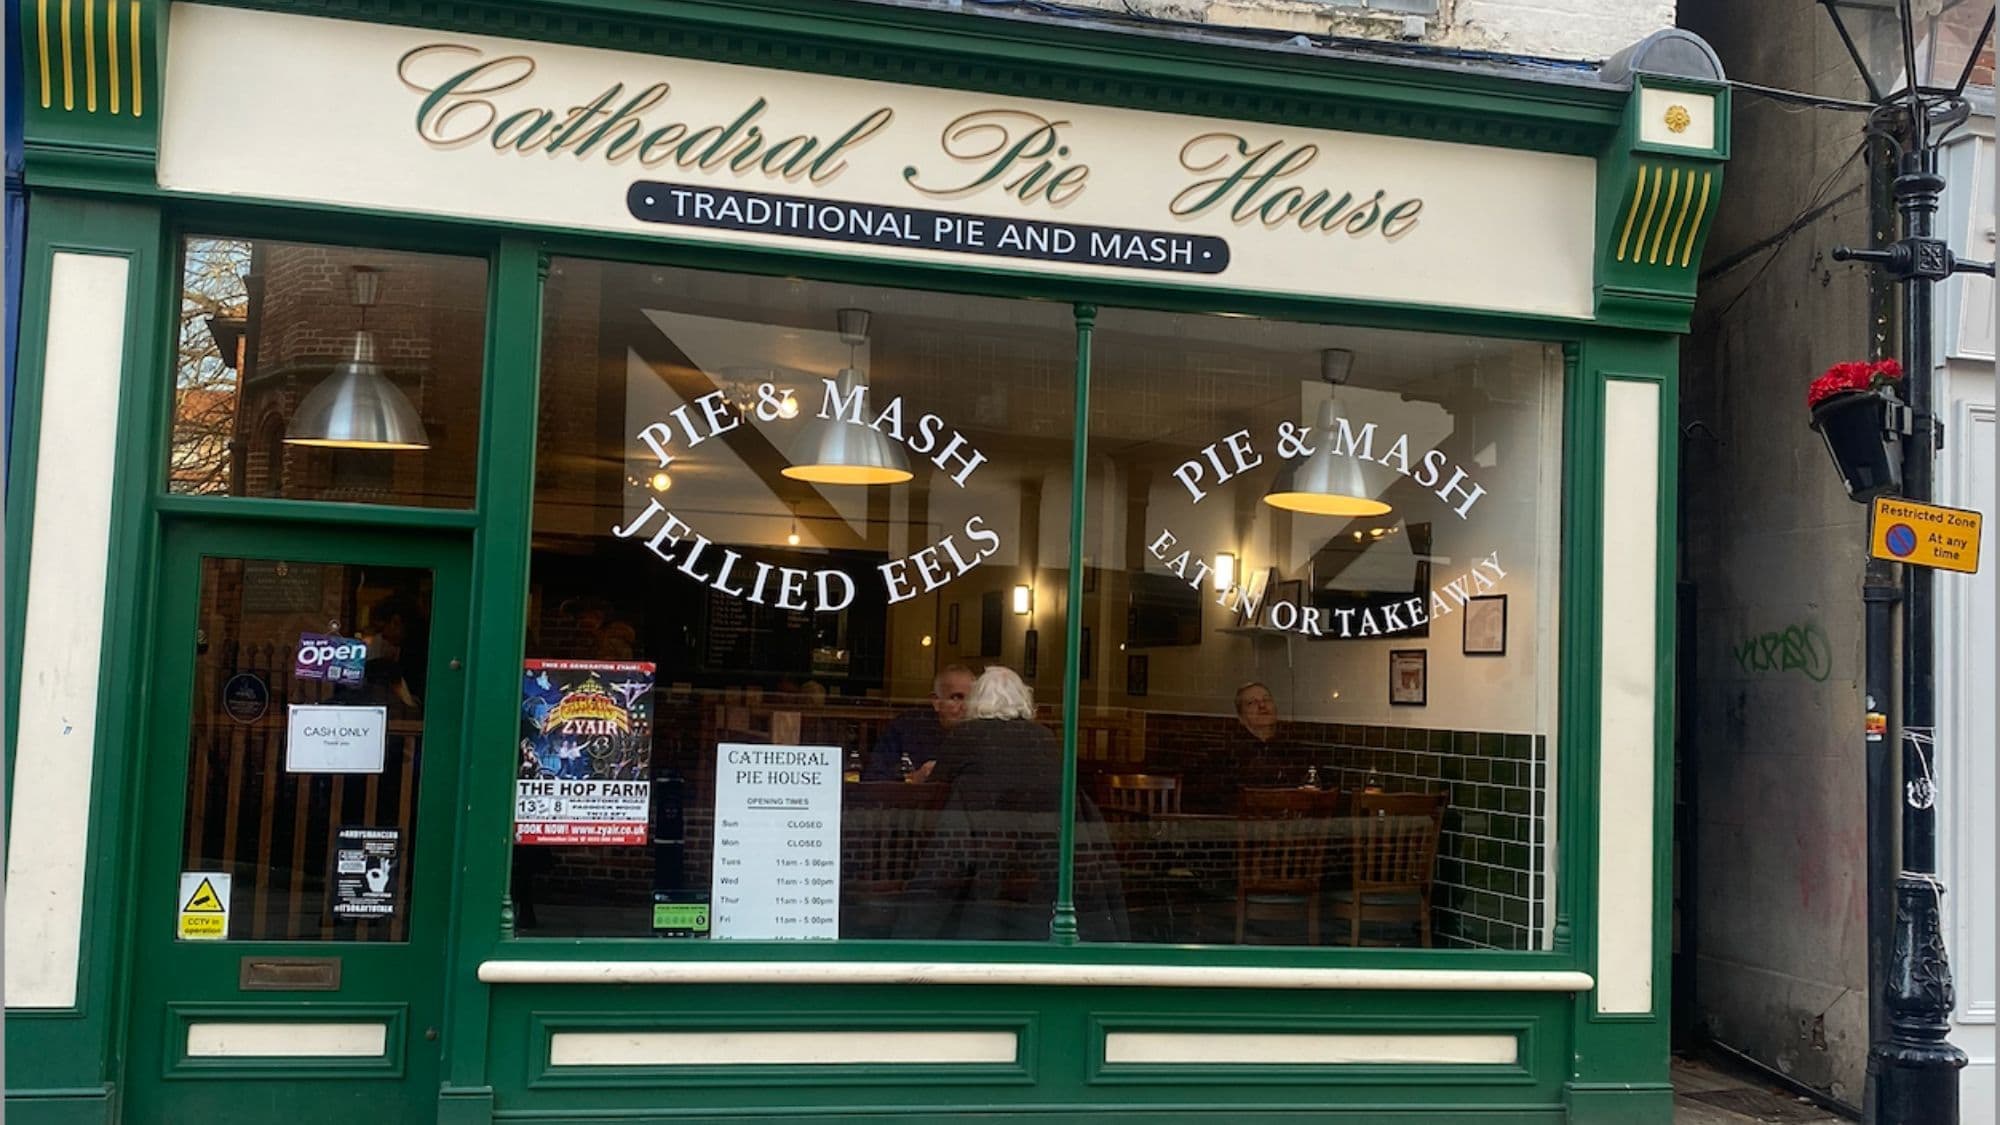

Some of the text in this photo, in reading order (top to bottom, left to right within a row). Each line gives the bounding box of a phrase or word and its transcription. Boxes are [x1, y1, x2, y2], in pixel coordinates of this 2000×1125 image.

[398, 43, 1424, 240] Cathedral Pie House
[670, 189, 1193, 265] TRADITIONAL PIE AND MASH
[637, 378, 988, 488] PIE & MASH
[1173, 417, 1487, 520] PIE & MASH
[1881, 504, 1977, 528] Restricted Zone
[1928, 532, 1968, 551] At any
[612, 497, 1000, 612] JELLIED EELS
[1934, 547, 1961, 561] time
[1148, 529, 1509, 639] EAT IN OR TAKEAWAY
[298, 644, 367, 666] Open
[303, 726, 370, 738] CASH ONLY
[562, 719, 619, 736] ZYAIR
[727, 750, 830, 767] CATHEDRAL
[736, 771, 822, 786] PIE HOUSE
[520, 782, 648, 797] THE HOP FARM
[519, 800, 537, 813] 13
[747, 797, 810, 806] OPENING TIMES
[786, 820, 823, 830] CLOSED
[786, 839, 823, 848] CLOSED
[188, 918, 210, 926] CCTV
